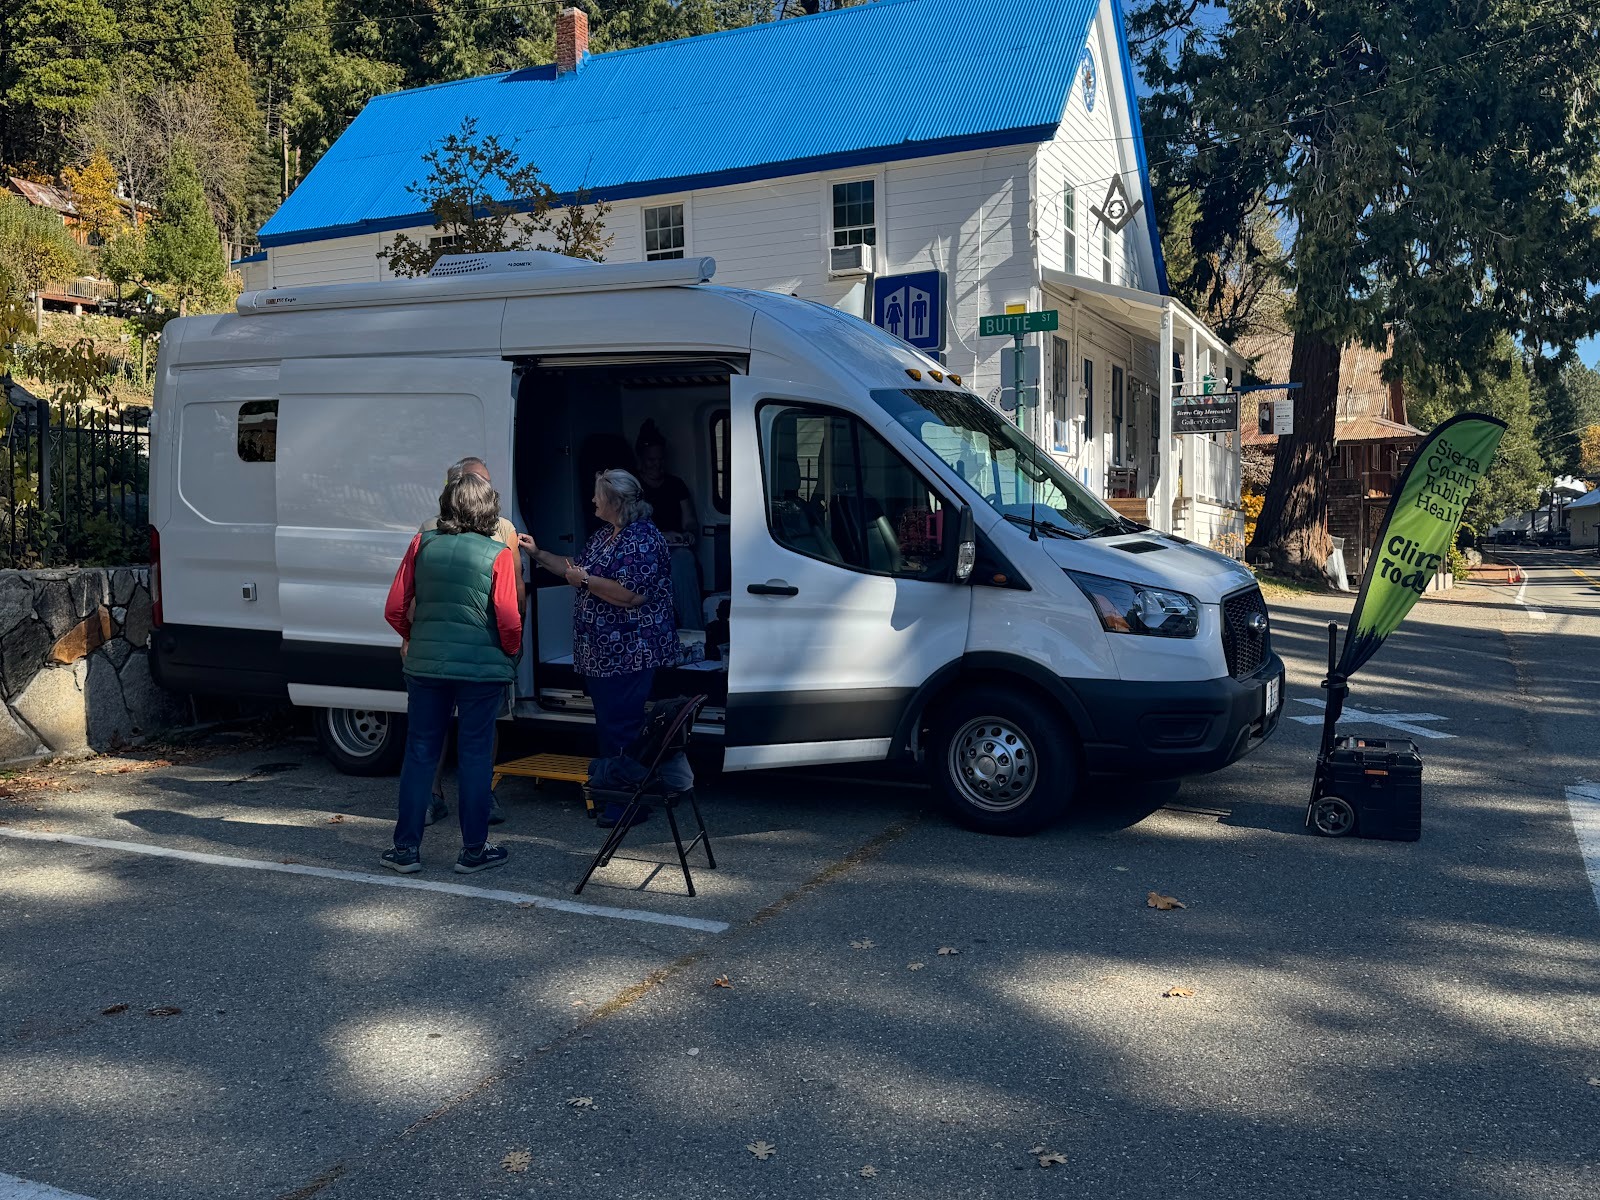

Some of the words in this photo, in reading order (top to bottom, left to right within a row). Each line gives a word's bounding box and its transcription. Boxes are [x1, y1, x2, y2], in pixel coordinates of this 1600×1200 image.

[986, 315, 1031, 334] BUTTE
[1041, 313, 1051, 322] ST
[1181, 418, 1203, 427] Gallery
[1193, 409, 1204, 417] City
[1435, 438, 1480, 474] Sierra
[1422, 473, 1470, 508] Public
[1427, 455, 1477, 495] County
[1414, 492, 1460, 524] Healt
